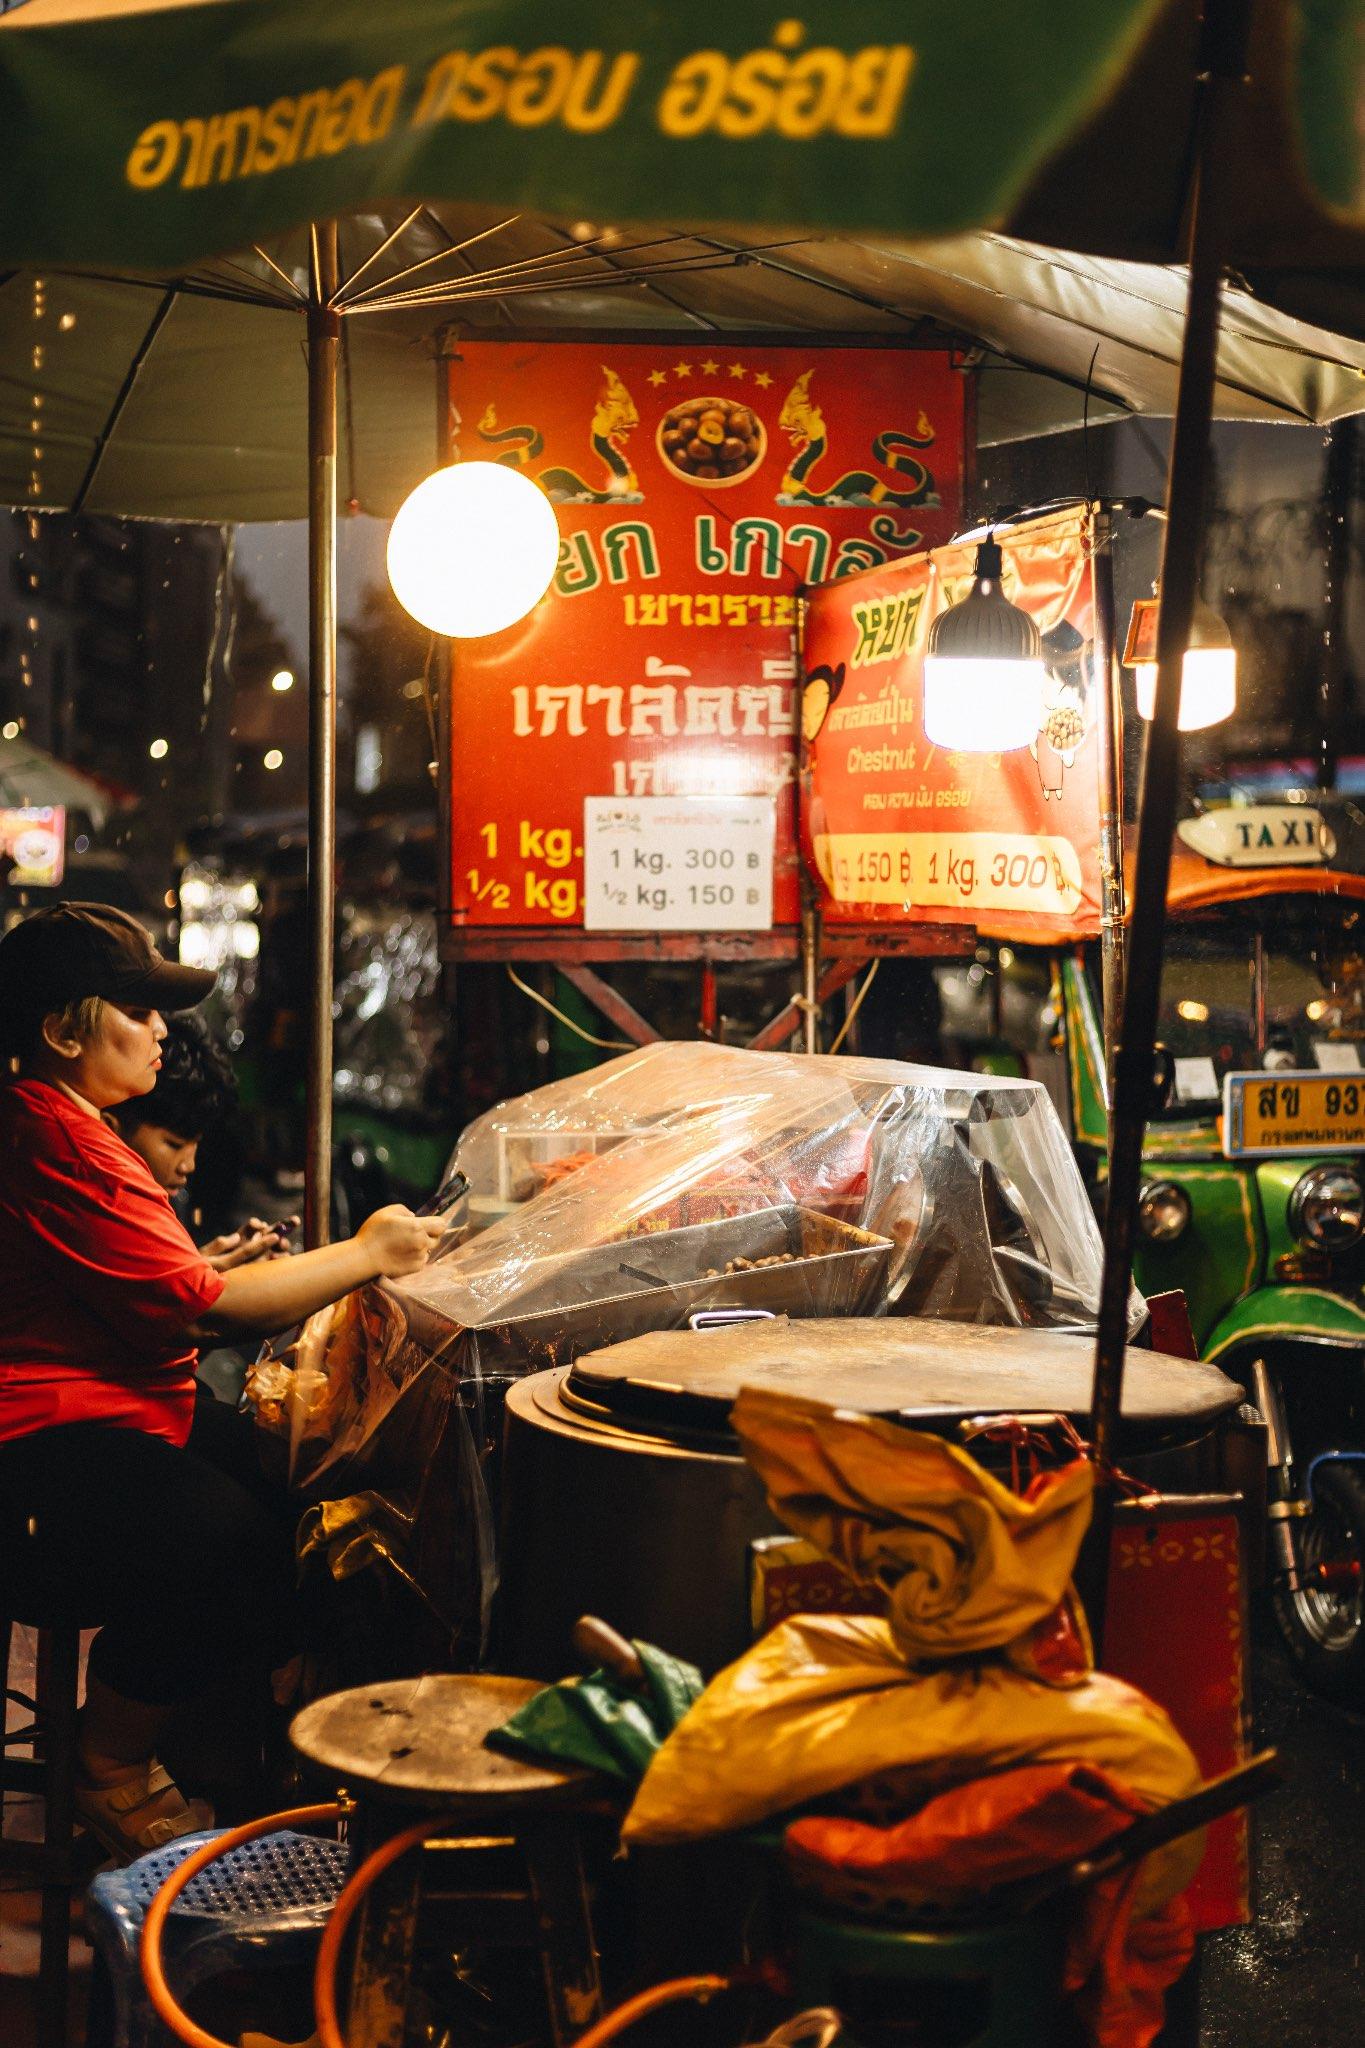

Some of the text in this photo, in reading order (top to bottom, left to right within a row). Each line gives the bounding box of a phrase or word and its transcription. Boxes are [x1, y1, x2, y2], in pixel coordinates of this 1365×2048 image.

[412, 45, 640, 133] กรอบ
[658, 18, 914, 138] อร่อย
[846, 743, 917, 774] Chestnut
[935, 782, 973, 807] อร่อย
[480, 822, 498, 858] 1
[519, 820, 584, 868] kg.
[1236, 820, 1315, 848] TAXI
[610, 849, 620, 869] 1
[634, 848, 672, 875] kg.
[685, 849, 735, 869] 300
[857, 851, 891, 882] 150
[928, 852, 939, 884] 1
[947, 849, 979, 896] kg.
[990, 853, 1048, 888] 300
[637, 884, 675, 911] kg.
[689, 885, 735, 905] 150
[1325, 1084, 1365, 1117] 93
